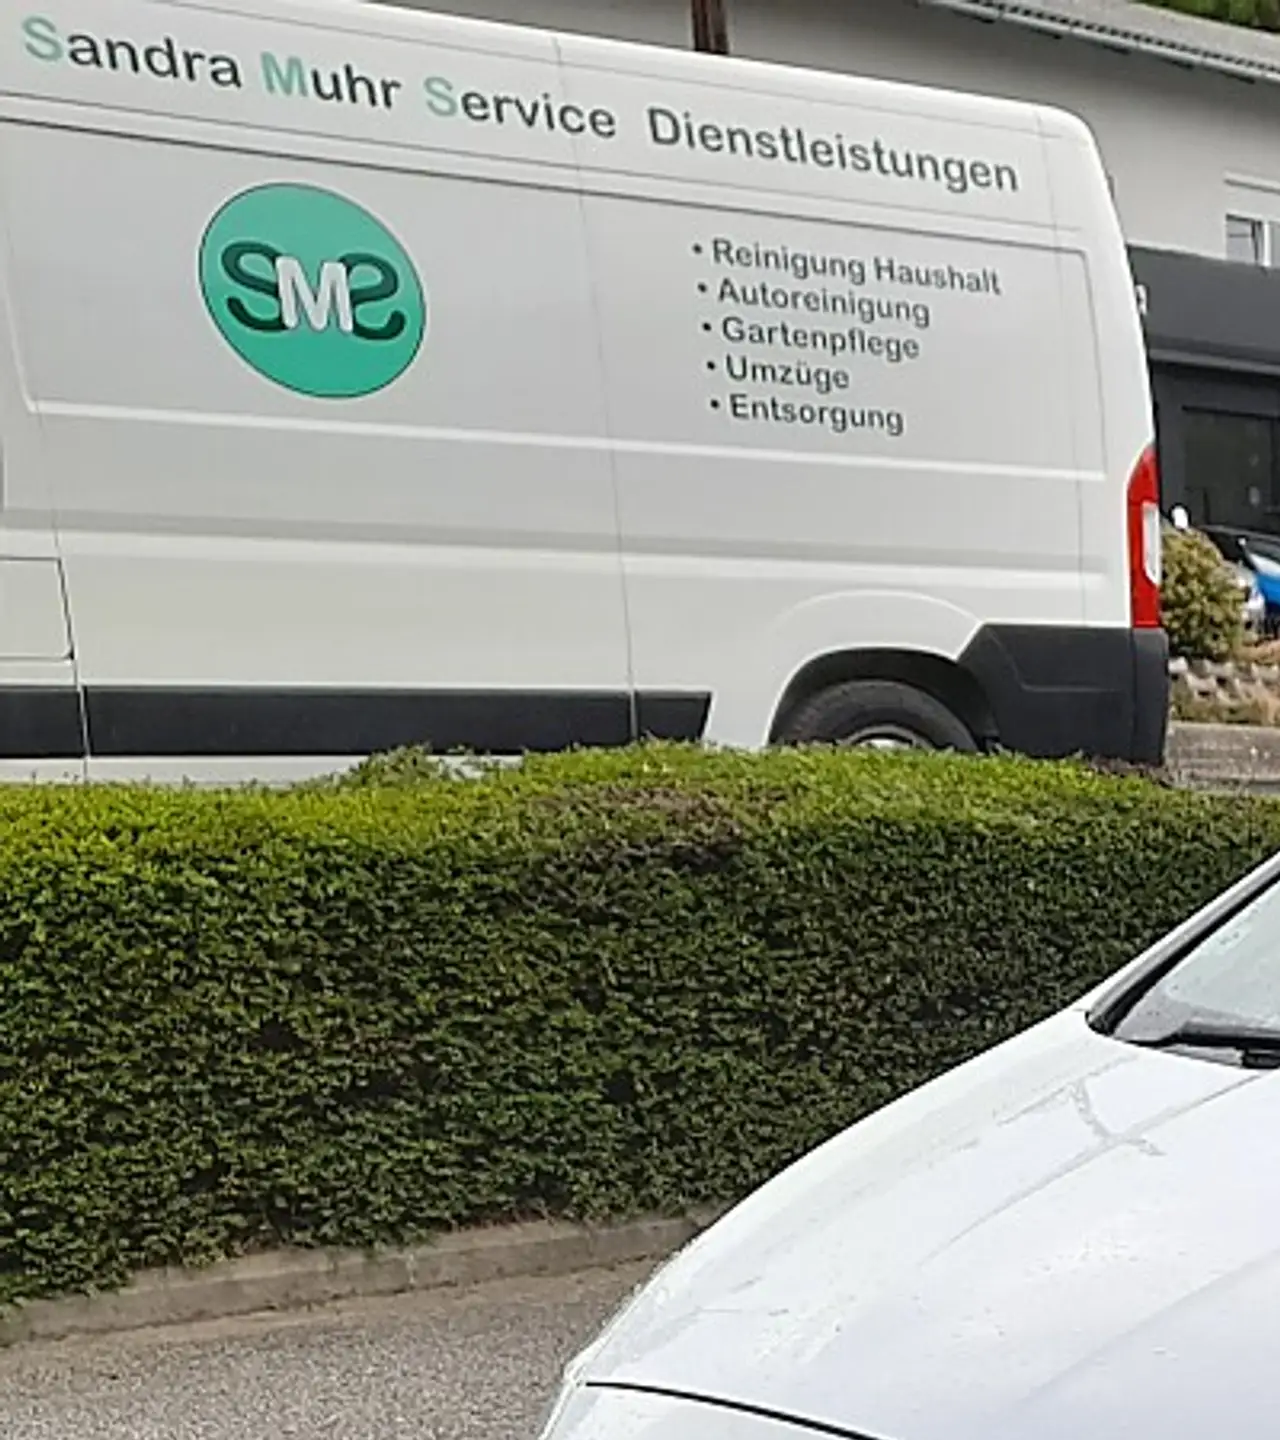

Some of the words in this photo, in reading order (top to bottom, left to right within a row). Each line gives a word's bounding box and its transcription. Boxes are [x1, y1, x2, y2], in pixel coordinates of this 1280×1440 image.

[21, 17, 241, 89] Sandra
[260, 51, 401, 109] Muhr
[423, 76, 617, 138] Service
[648, 107, 1018, 193] Dienstleistungen
[712, 237, 866, 285] Reinigung
[873, 257, 1001, 296] Haushalt
[717, 277, 930, 328] Autoreinigung
[721, 316, 920, 363] Gartenpflege
[726, 355, 850, 393] Umzüge
[729, 394, 905, 436] Entsorgung
